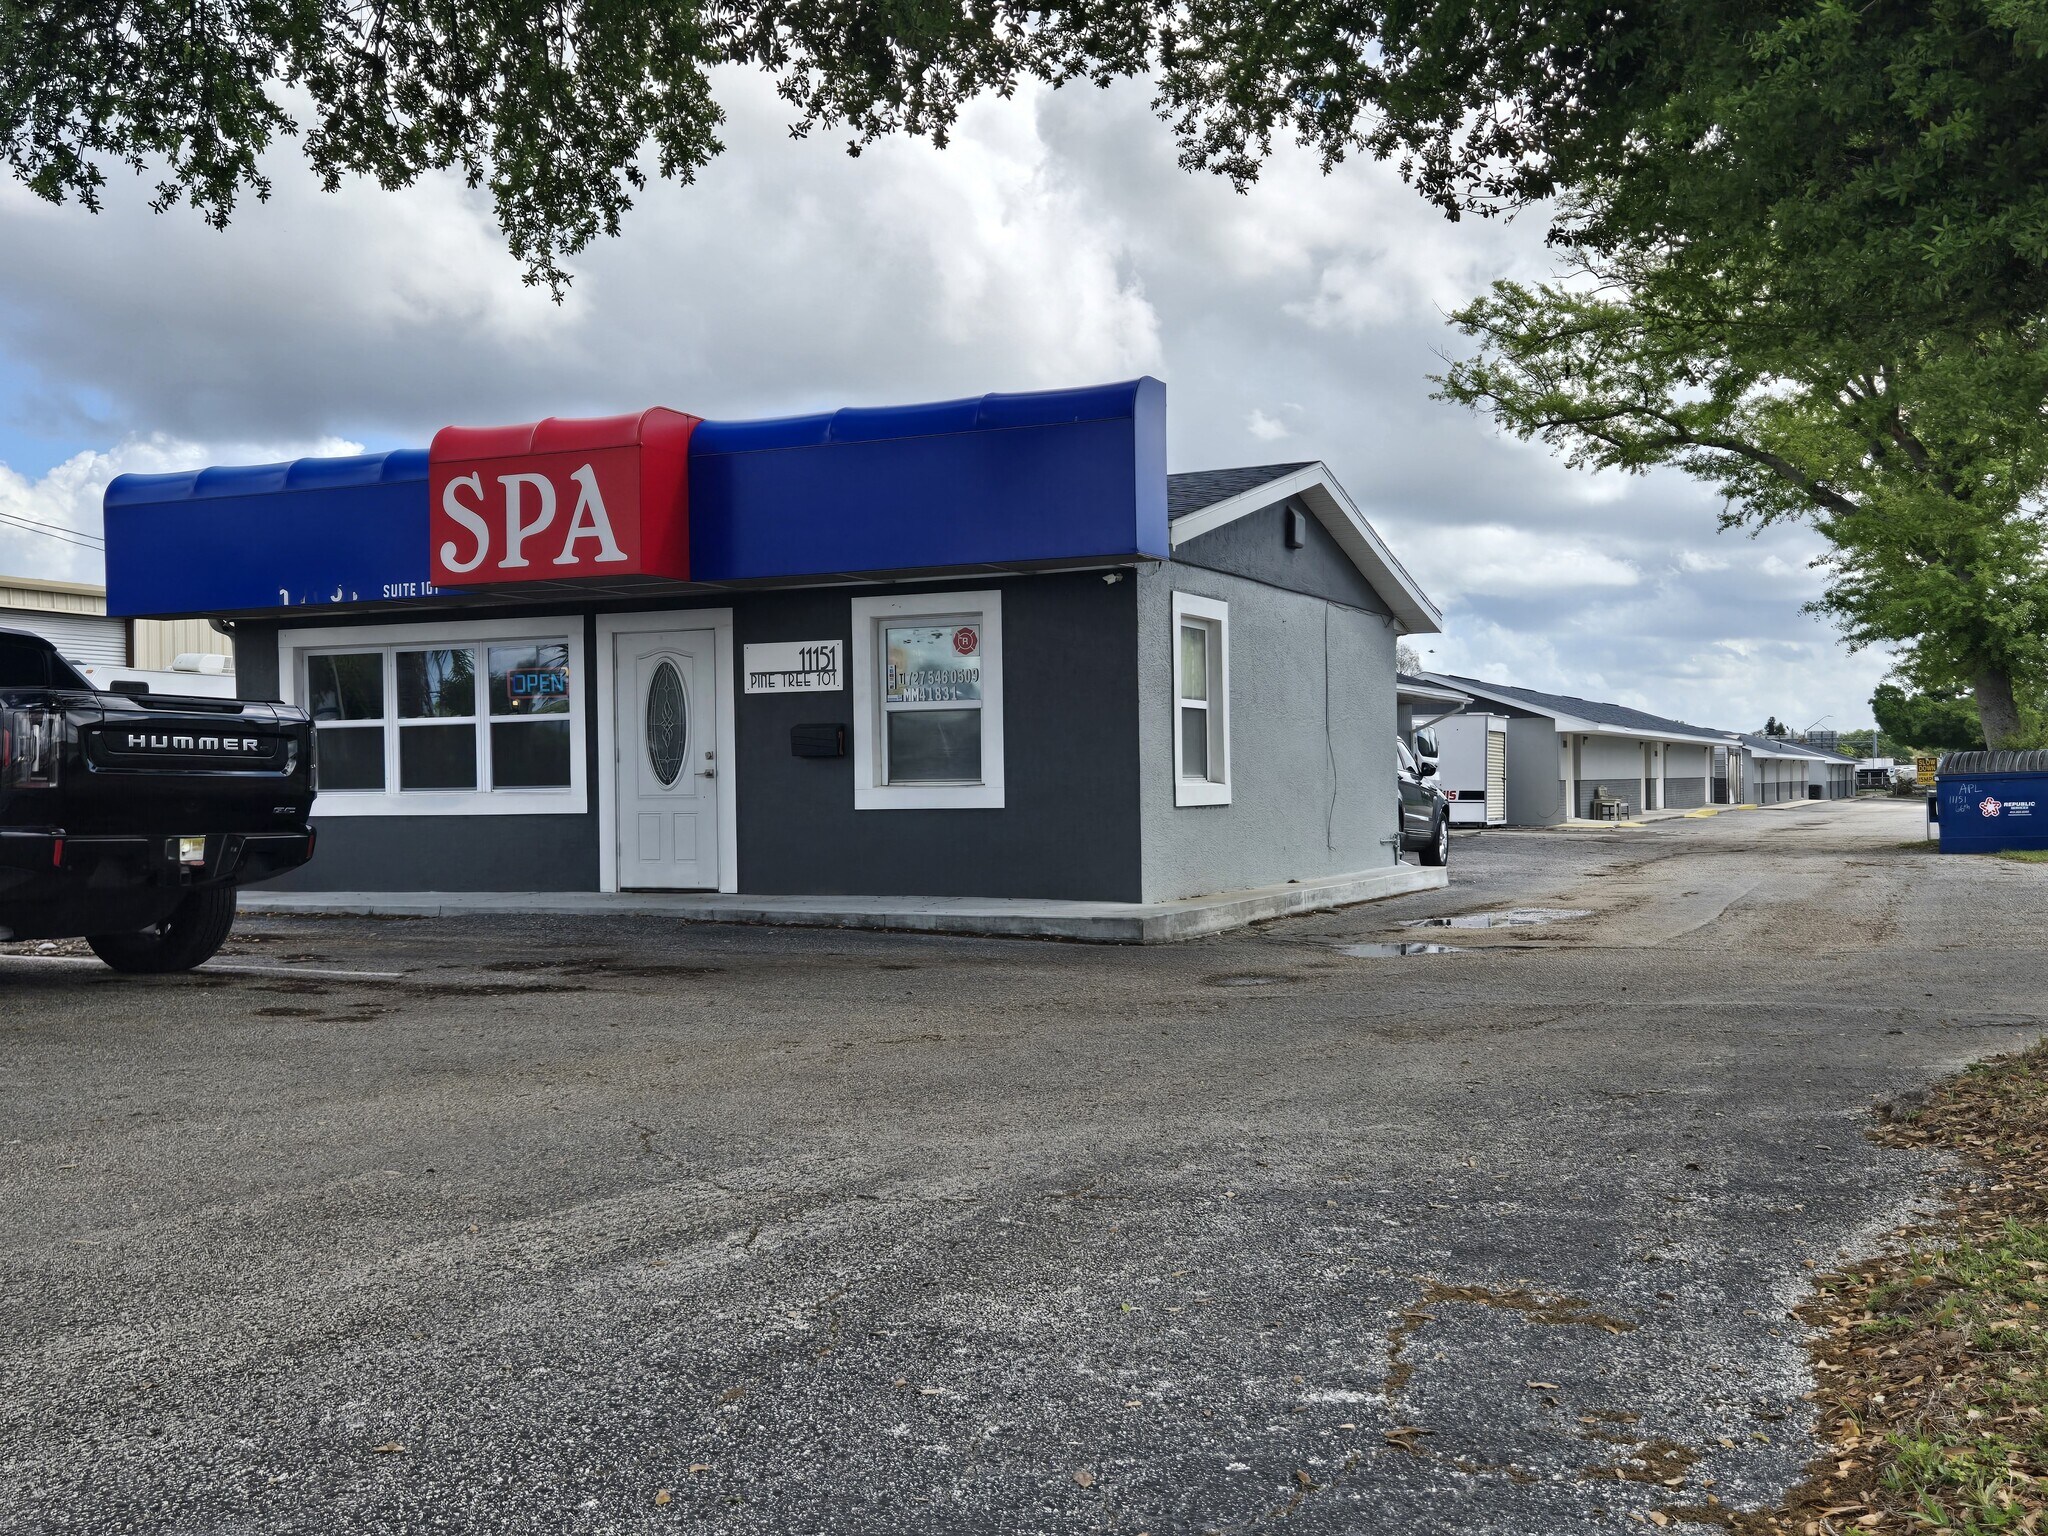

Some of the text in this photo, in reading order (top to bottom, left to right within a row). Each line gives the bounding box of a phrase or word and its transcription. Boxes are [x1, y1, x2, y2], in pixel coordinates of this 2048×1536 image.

[440, 463, 628, 573] SPA
[383, 582, 416, 598] SUITE
[799, 646, 836, 671] 11151
[513, 673, 564, 693] OPEN
[750, 671, 836, 689] PINE TREE 101
[928, 669, 950, 685] 546
[903, 686, 958, 701] MM41831
[128, 734, 259, 751] HUMMER
